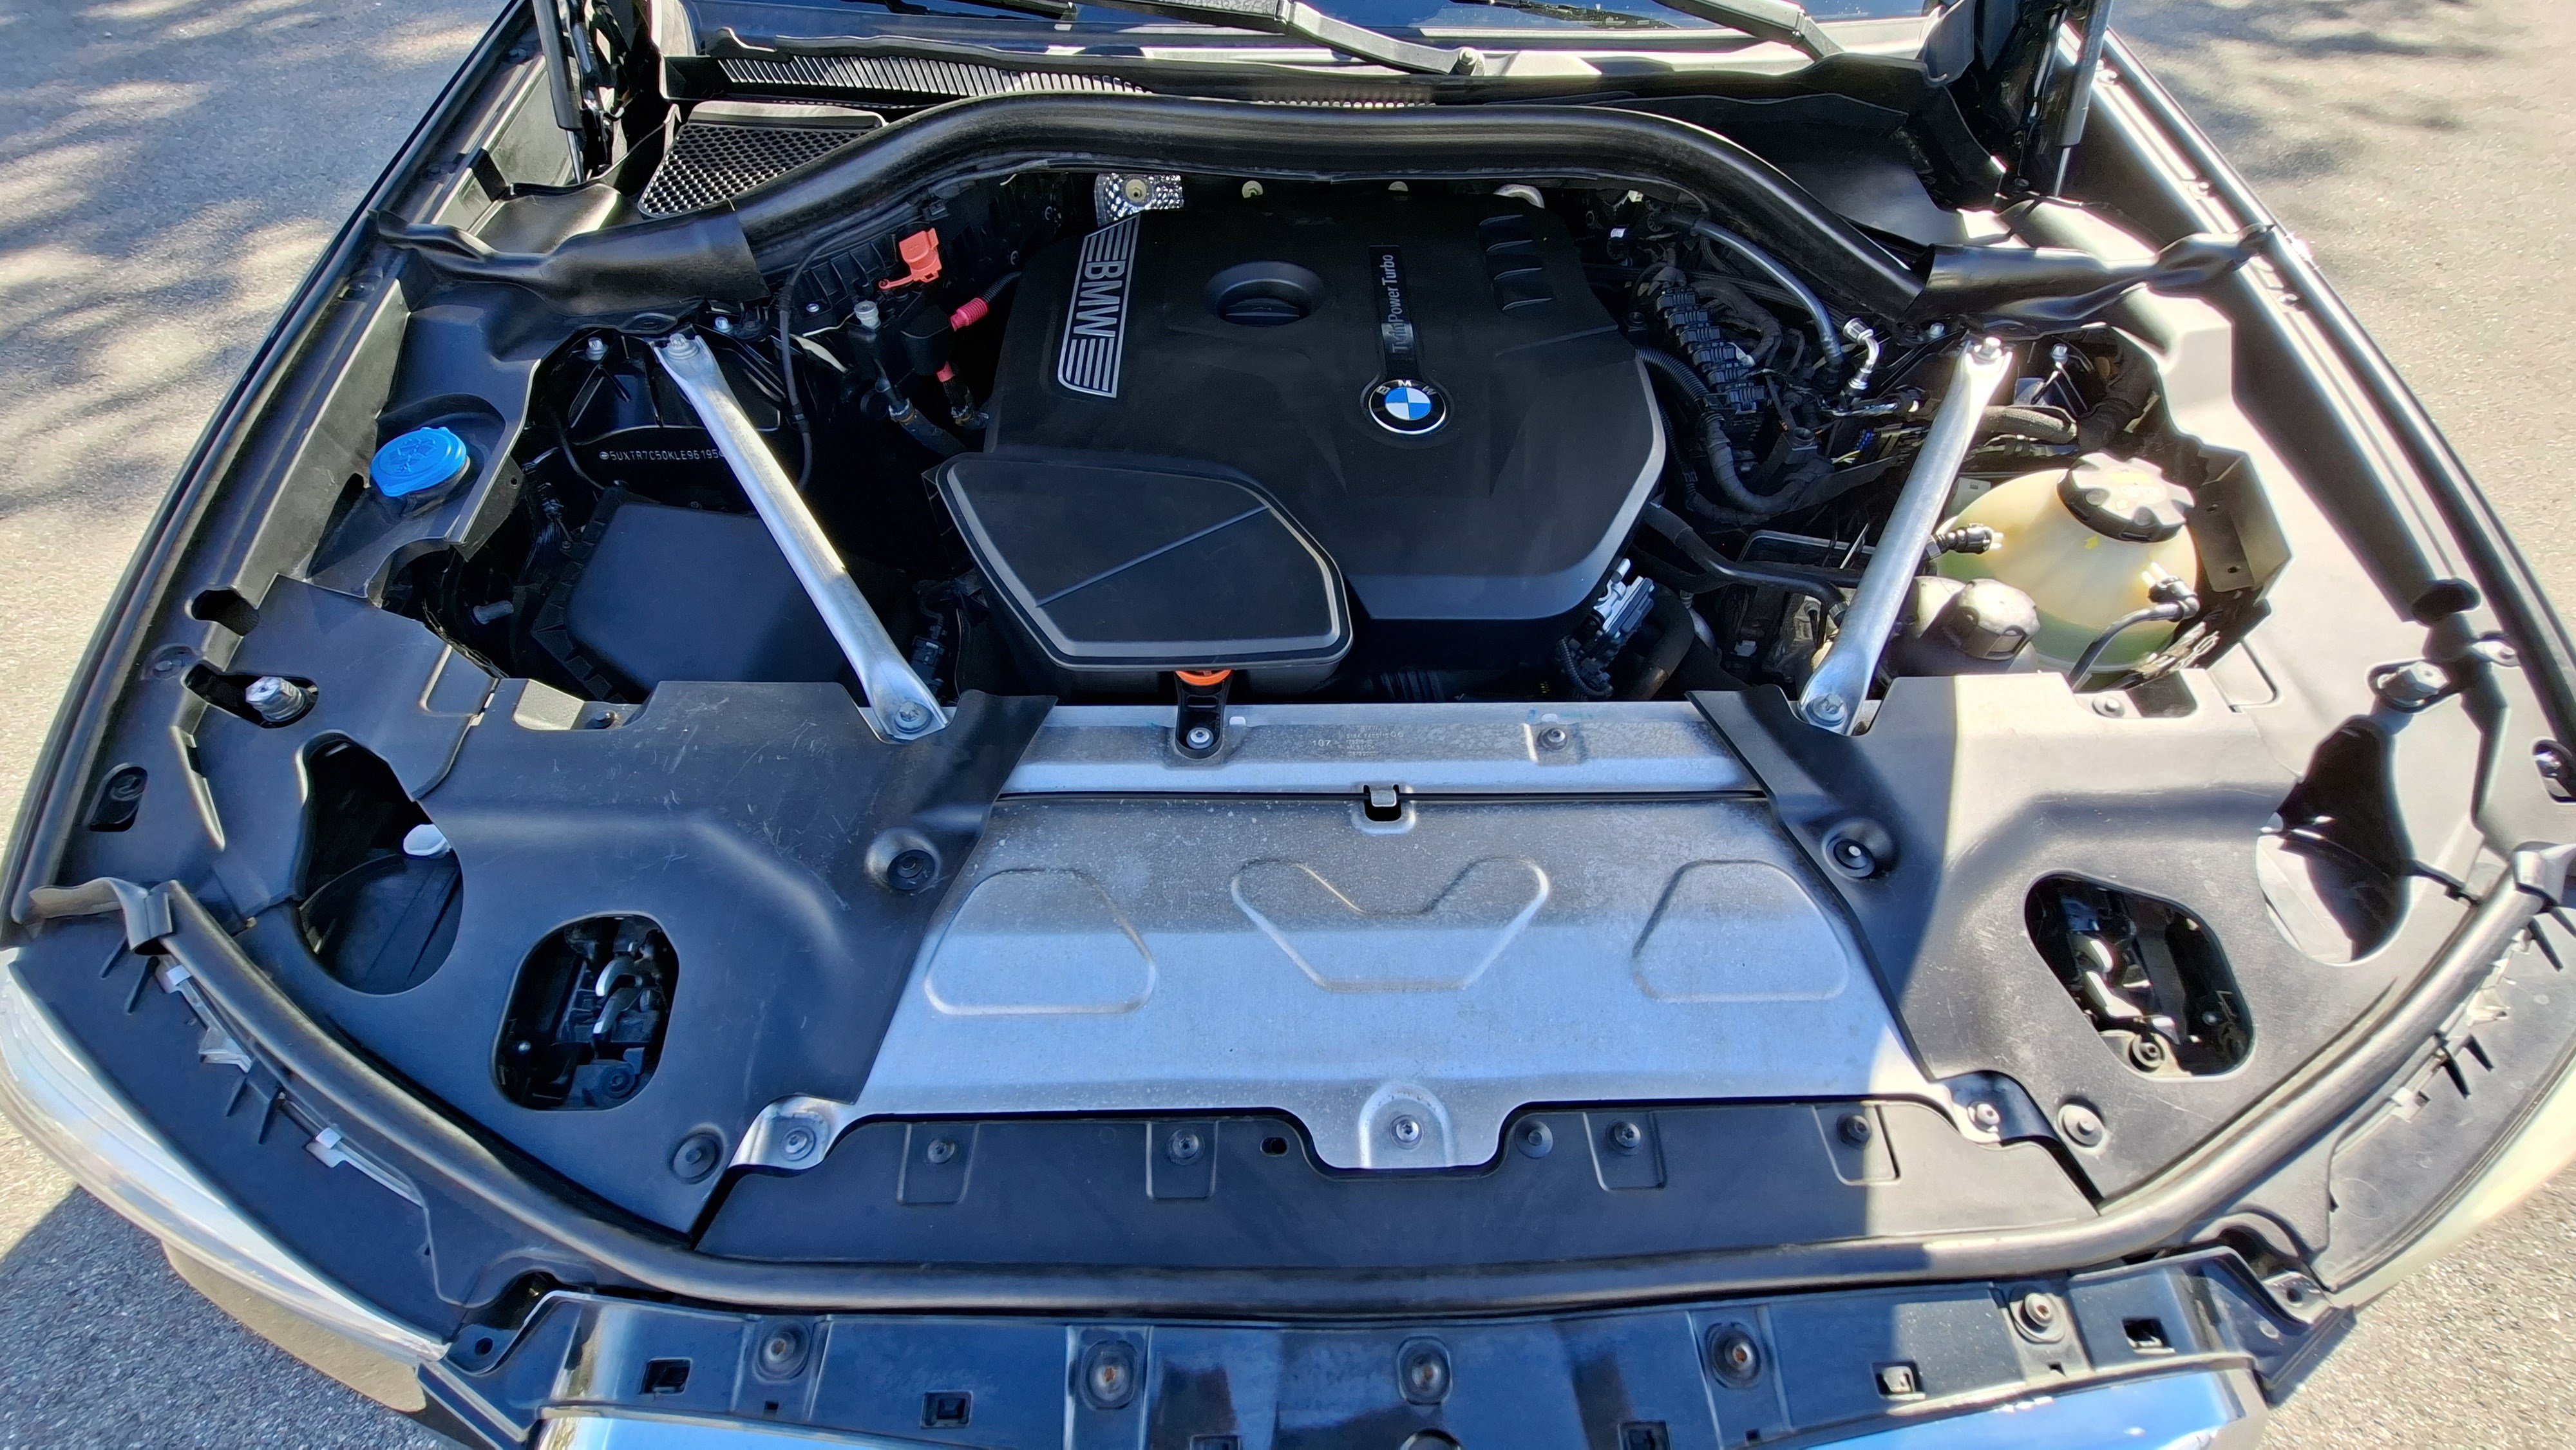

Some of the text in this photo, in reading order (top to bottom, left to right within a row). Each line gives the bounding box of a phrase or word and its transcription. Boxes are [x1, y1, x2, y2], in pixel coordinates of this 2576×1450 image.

[1073, 260, 1126, 337] BMW
[1380, 254, 1409, 353] TwinPower Turbo
[1376, 379, 1437, 395] BMW
